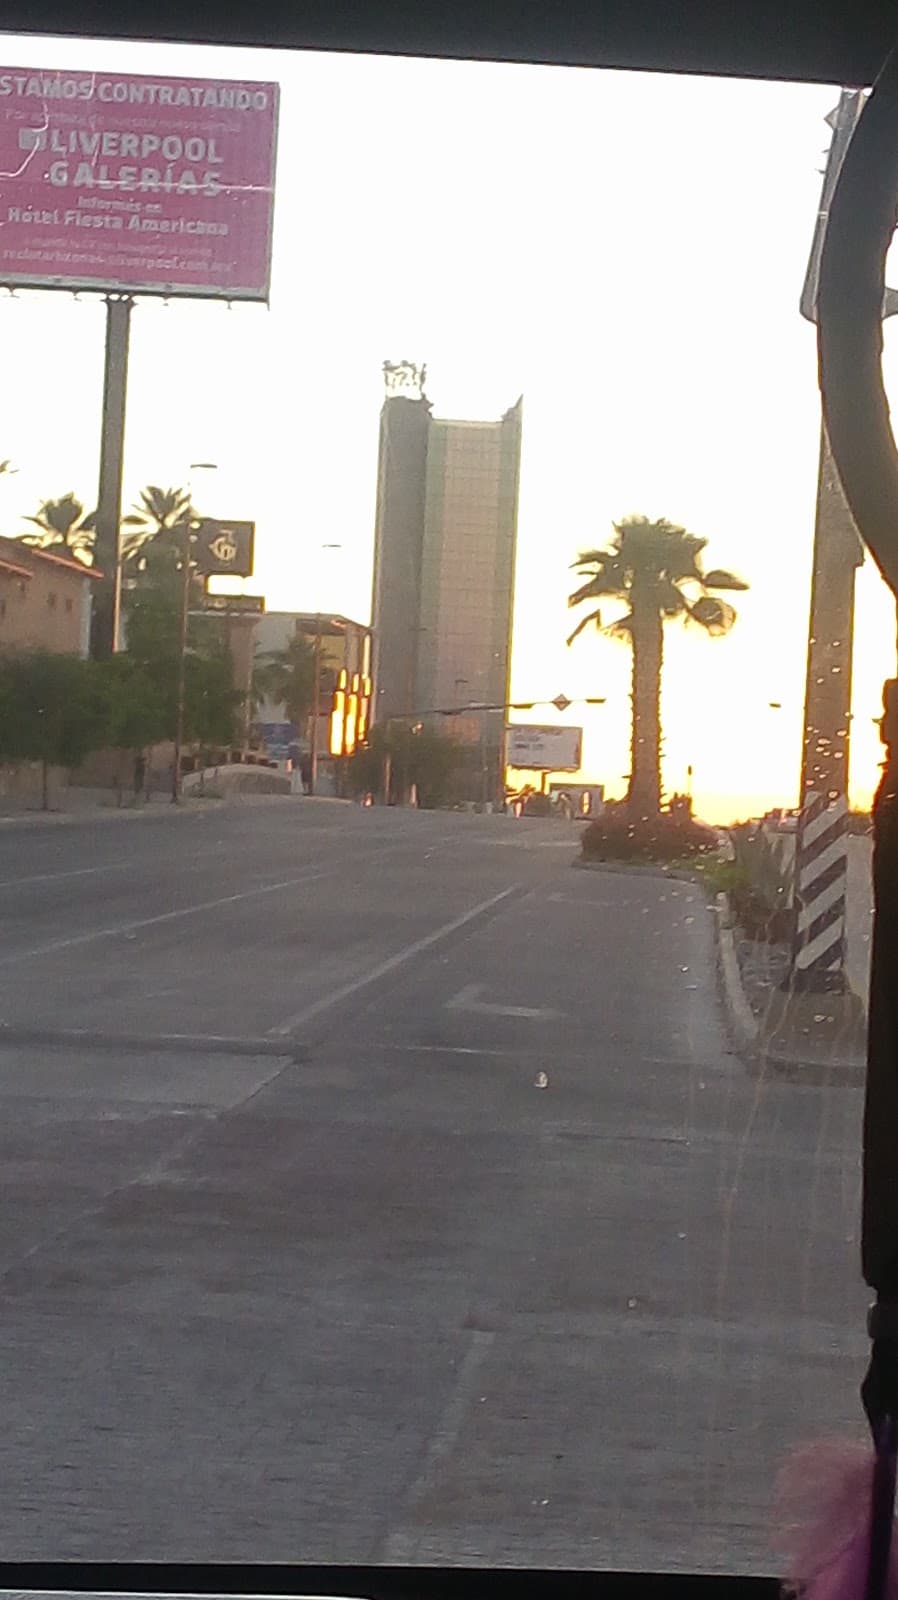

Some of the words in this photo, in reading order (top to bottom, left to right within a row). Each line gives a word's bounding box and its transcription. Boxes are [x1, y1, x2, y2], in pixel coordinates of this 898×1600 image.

[98, 81, 268, 111] CONTRATANDO
[50, 128, 224, 164] LIVERPOOL
[49, 160, 221, 197] GALERÍAS
[8, 206, 59, 225] Hotel
[64, 209, 123, 229] Fiesta
[128, 214, 229, 236] Americana
